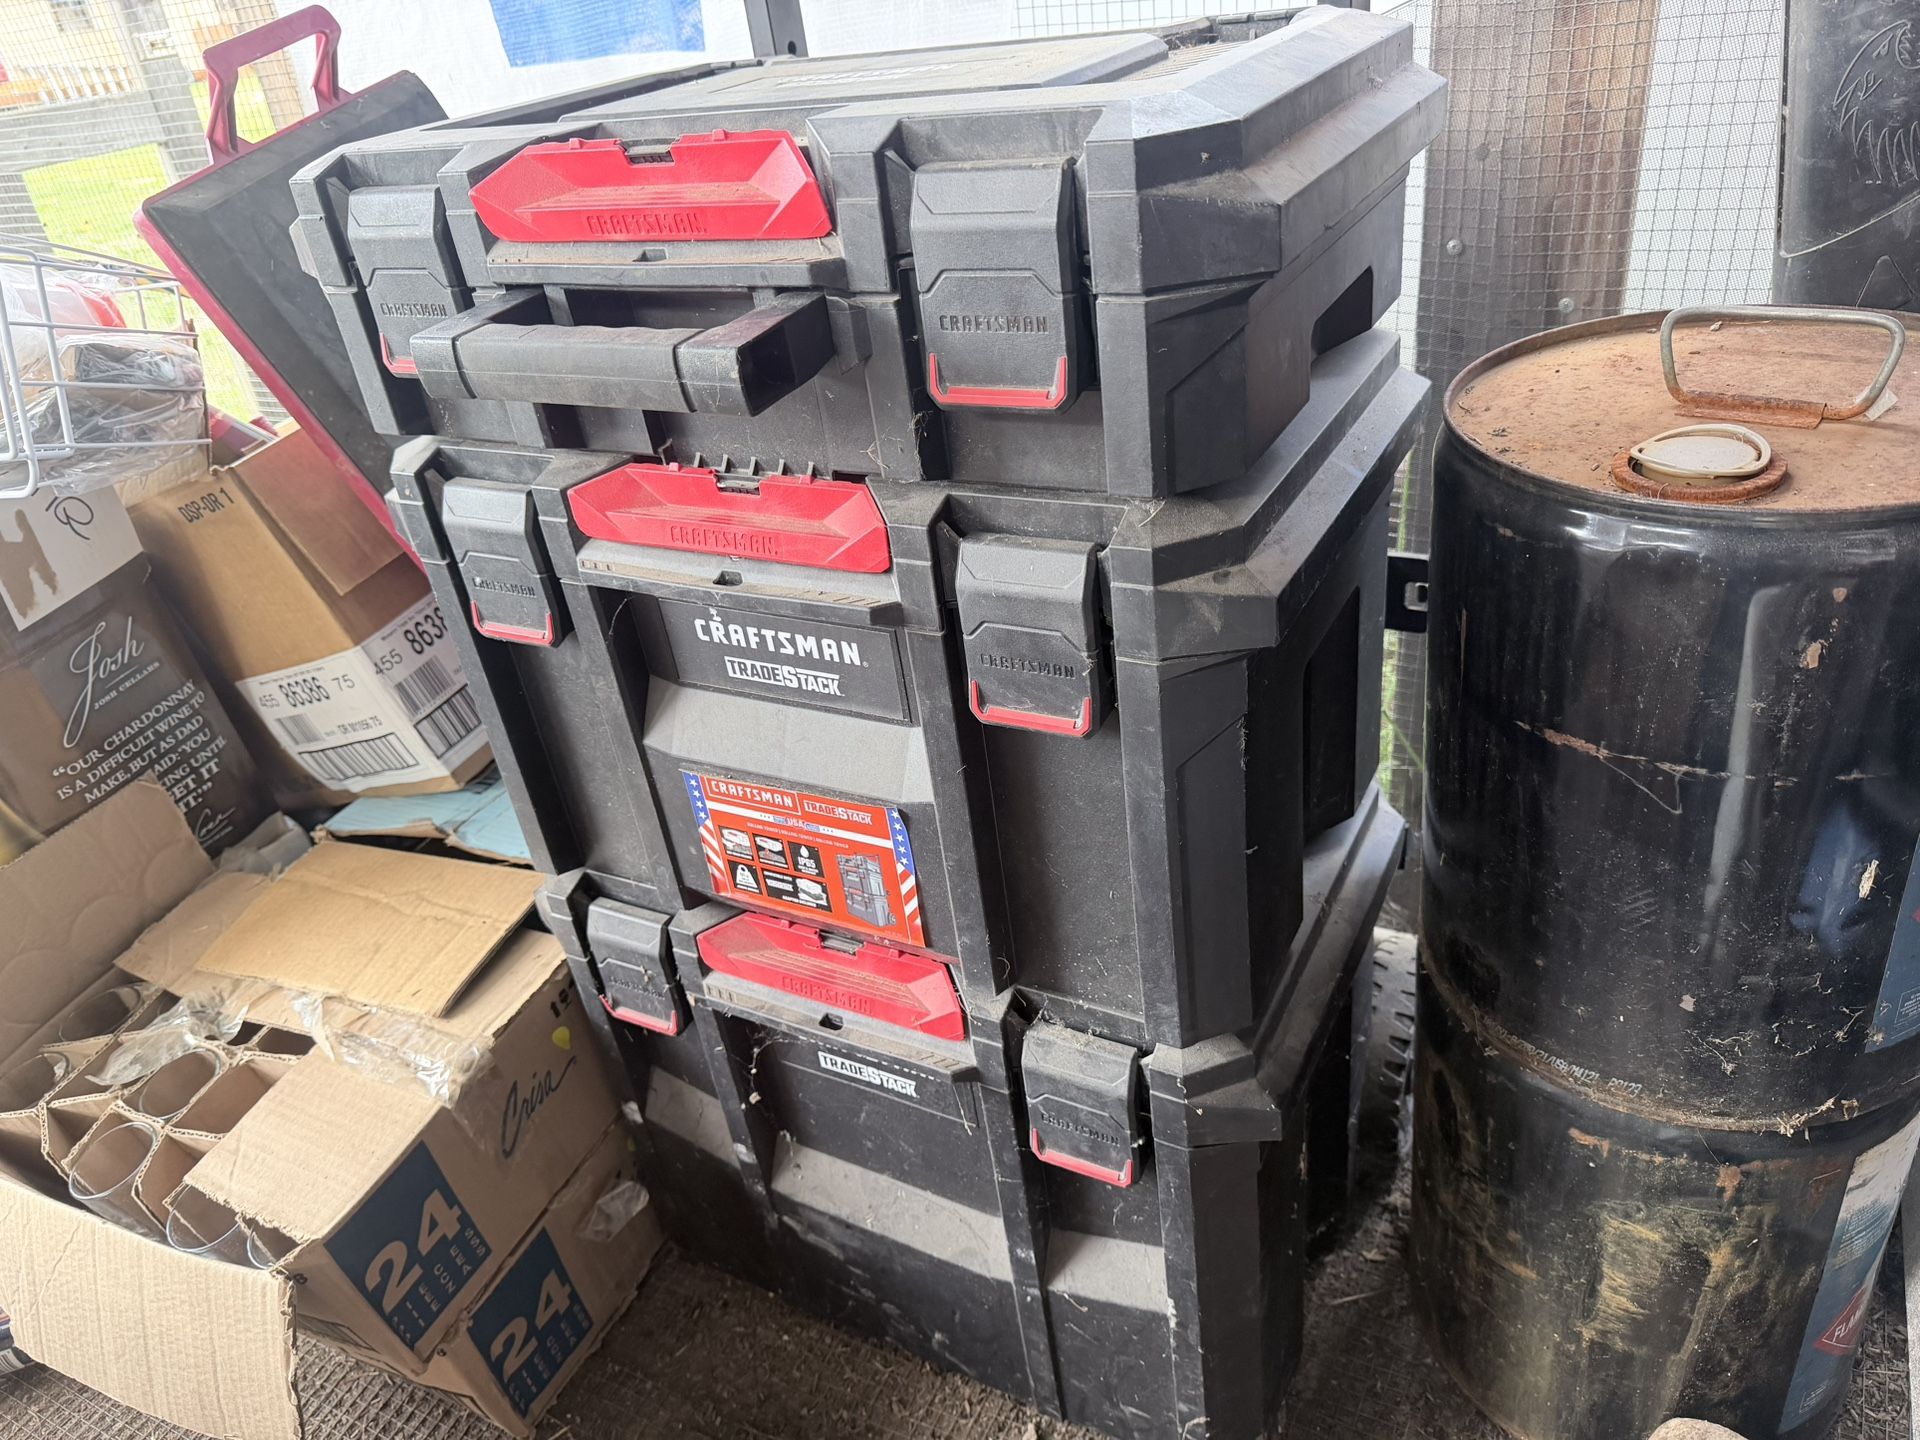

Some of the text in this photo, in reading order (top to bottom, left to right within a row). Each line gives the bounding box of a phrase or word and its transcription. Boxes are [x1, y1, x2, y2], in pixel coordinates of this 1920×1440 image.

[586, 212, 705, 235] CRAFTSMAN
[380, 302, 448, 318] CRAFTSMAN
[939, 314, 1049, 334] CRAFTSMAN
[220, 487, 235, 504] 1
[670, 525, 774, 555] CRAFTSMAN
[373, 648, 404, 676] 455
[980, 653, 1076, 680] CRAFTSMAN
[62, 616, 145, 748] Josh
[94, 661, 160, 710] JOSH CELLARS
[279, 676, 330, 708] 86386
[331, 674, 355, 692] 75
[103, 679, 196, 750] CHARDONNAY
[57, 691, 205, 800] IS A DIFFICULT WINE TO
[84, 716, 203, 804] MAKE, BUT AS DAD
[190, 736, 227, 766] UNTIL
[154, 754, 180, 775] AID:
[169, 758, 221, 800] ET IT
[711, 780, 793, 808] CRAFTSMAN
[782, 976, 872, 1014] CRAFTSMAN
[502, 1055, 576, 1159] Crisa
[1041, 1112, 1120, 1147] CRAFTSMAN
[365, 1188, 462, 1315] 24
[490, 1269, 572, 1383] 24
